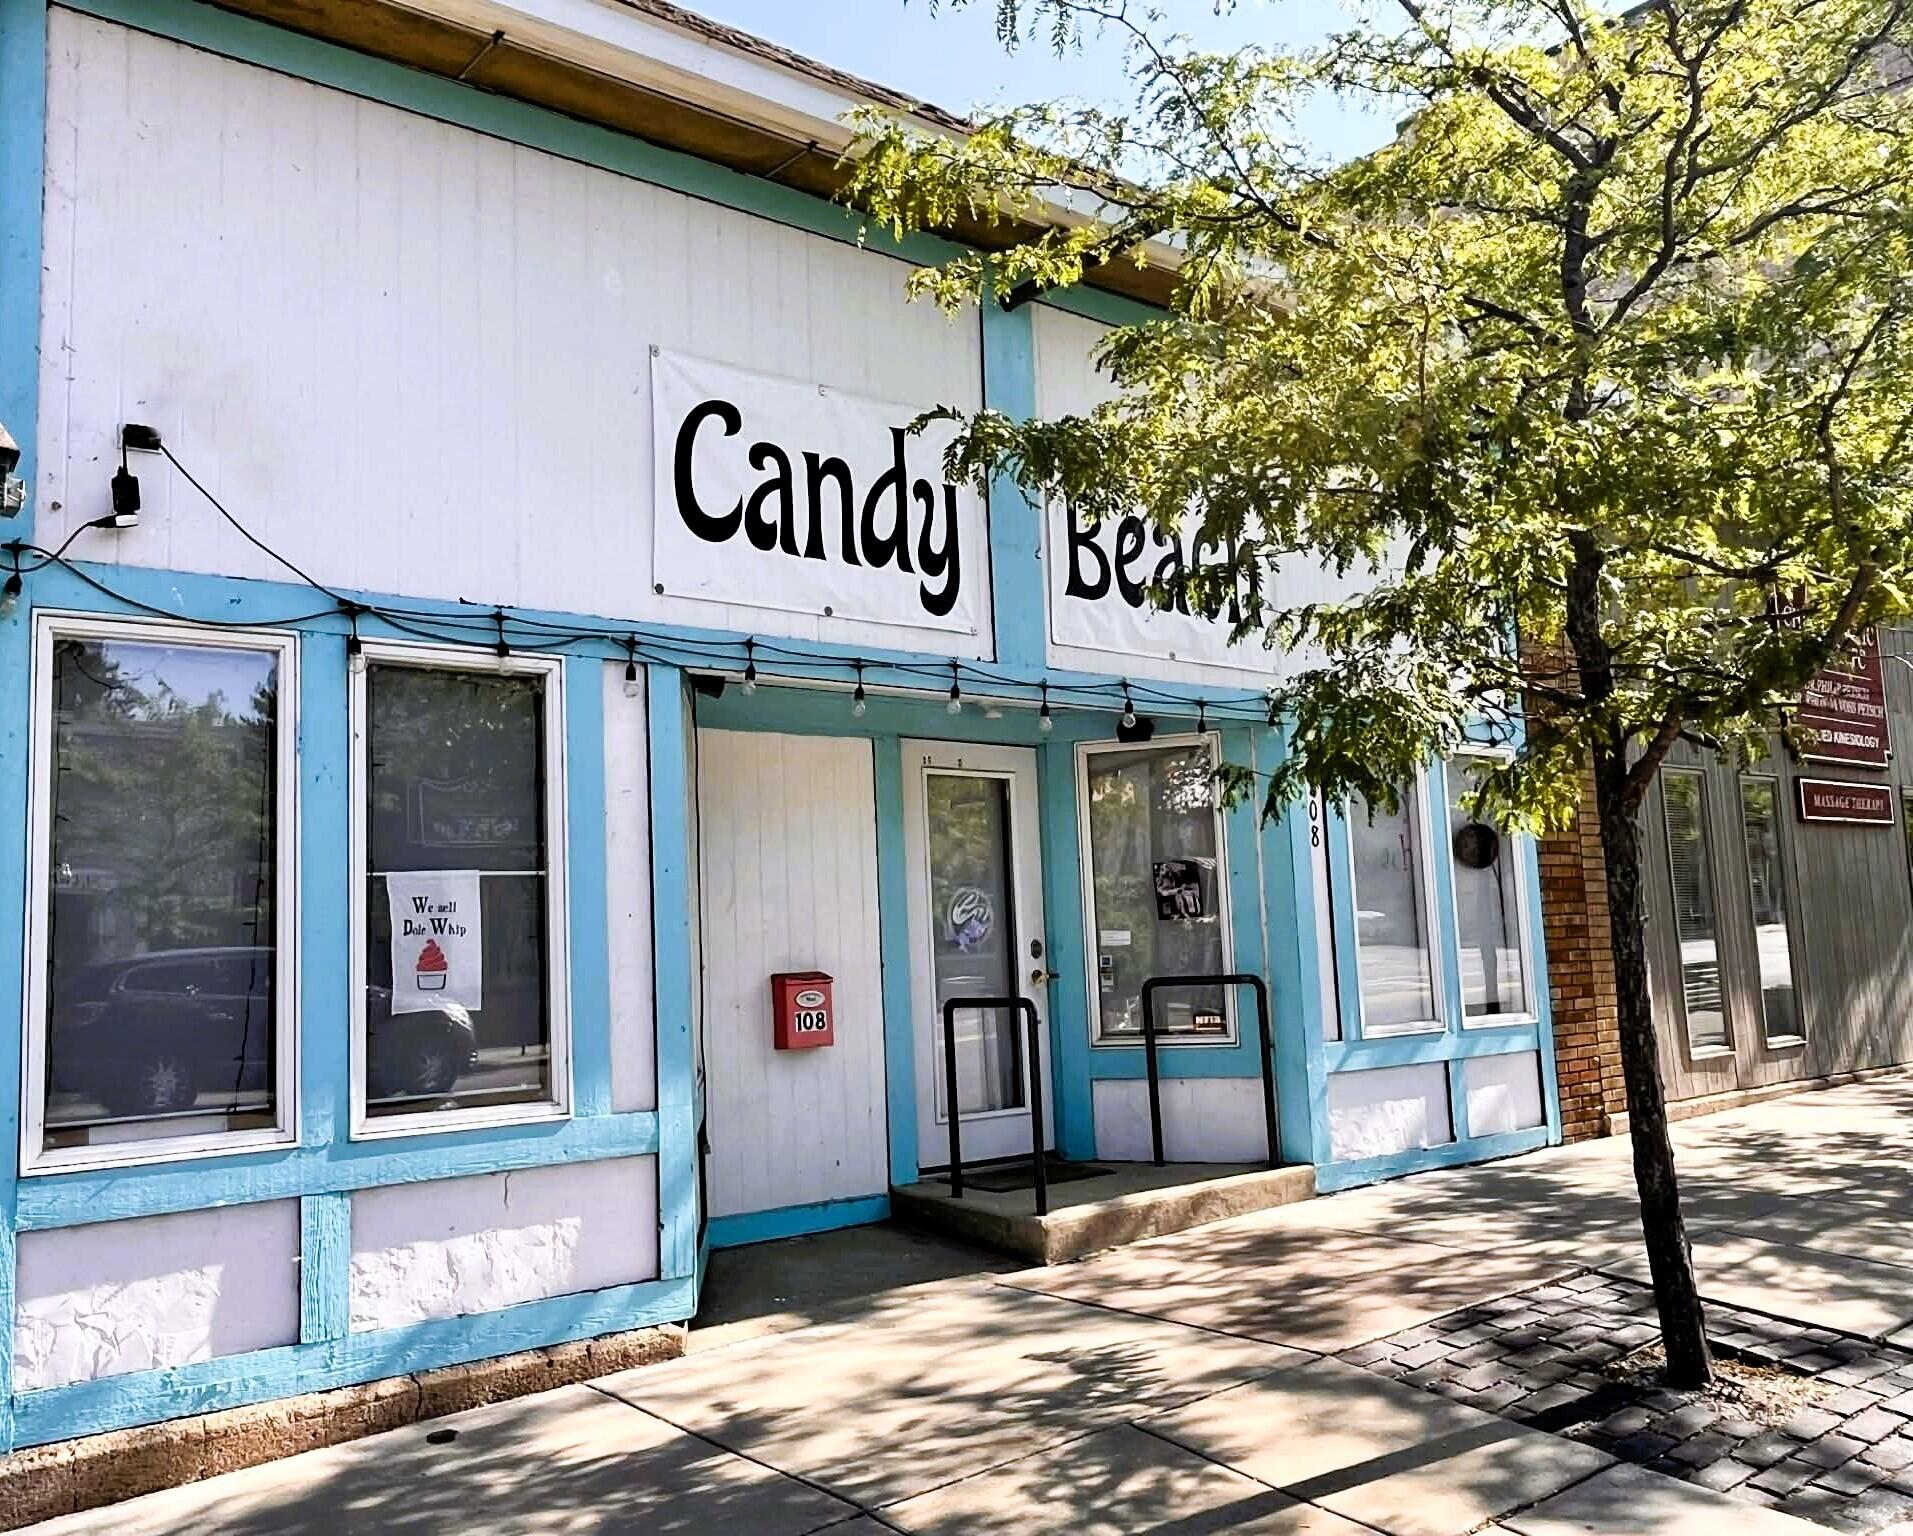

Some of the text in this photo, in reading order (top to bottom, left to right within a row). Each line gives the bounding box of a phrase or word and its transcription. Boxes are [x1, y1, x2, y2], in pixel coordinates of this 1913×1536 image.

[674, 400, 961, 617] Candy
[1857, 702, 1884, 719] PETSCH
[1833, 731, 1880, 749] KINESIOLOGY
[1813, 793, 1884, 812] MASSAGE THERAPY
[412, 896, 457, 914] We sell
[403, 917, 467, 937] Dole Whip
[796, 1011, 826, 1032] 108
